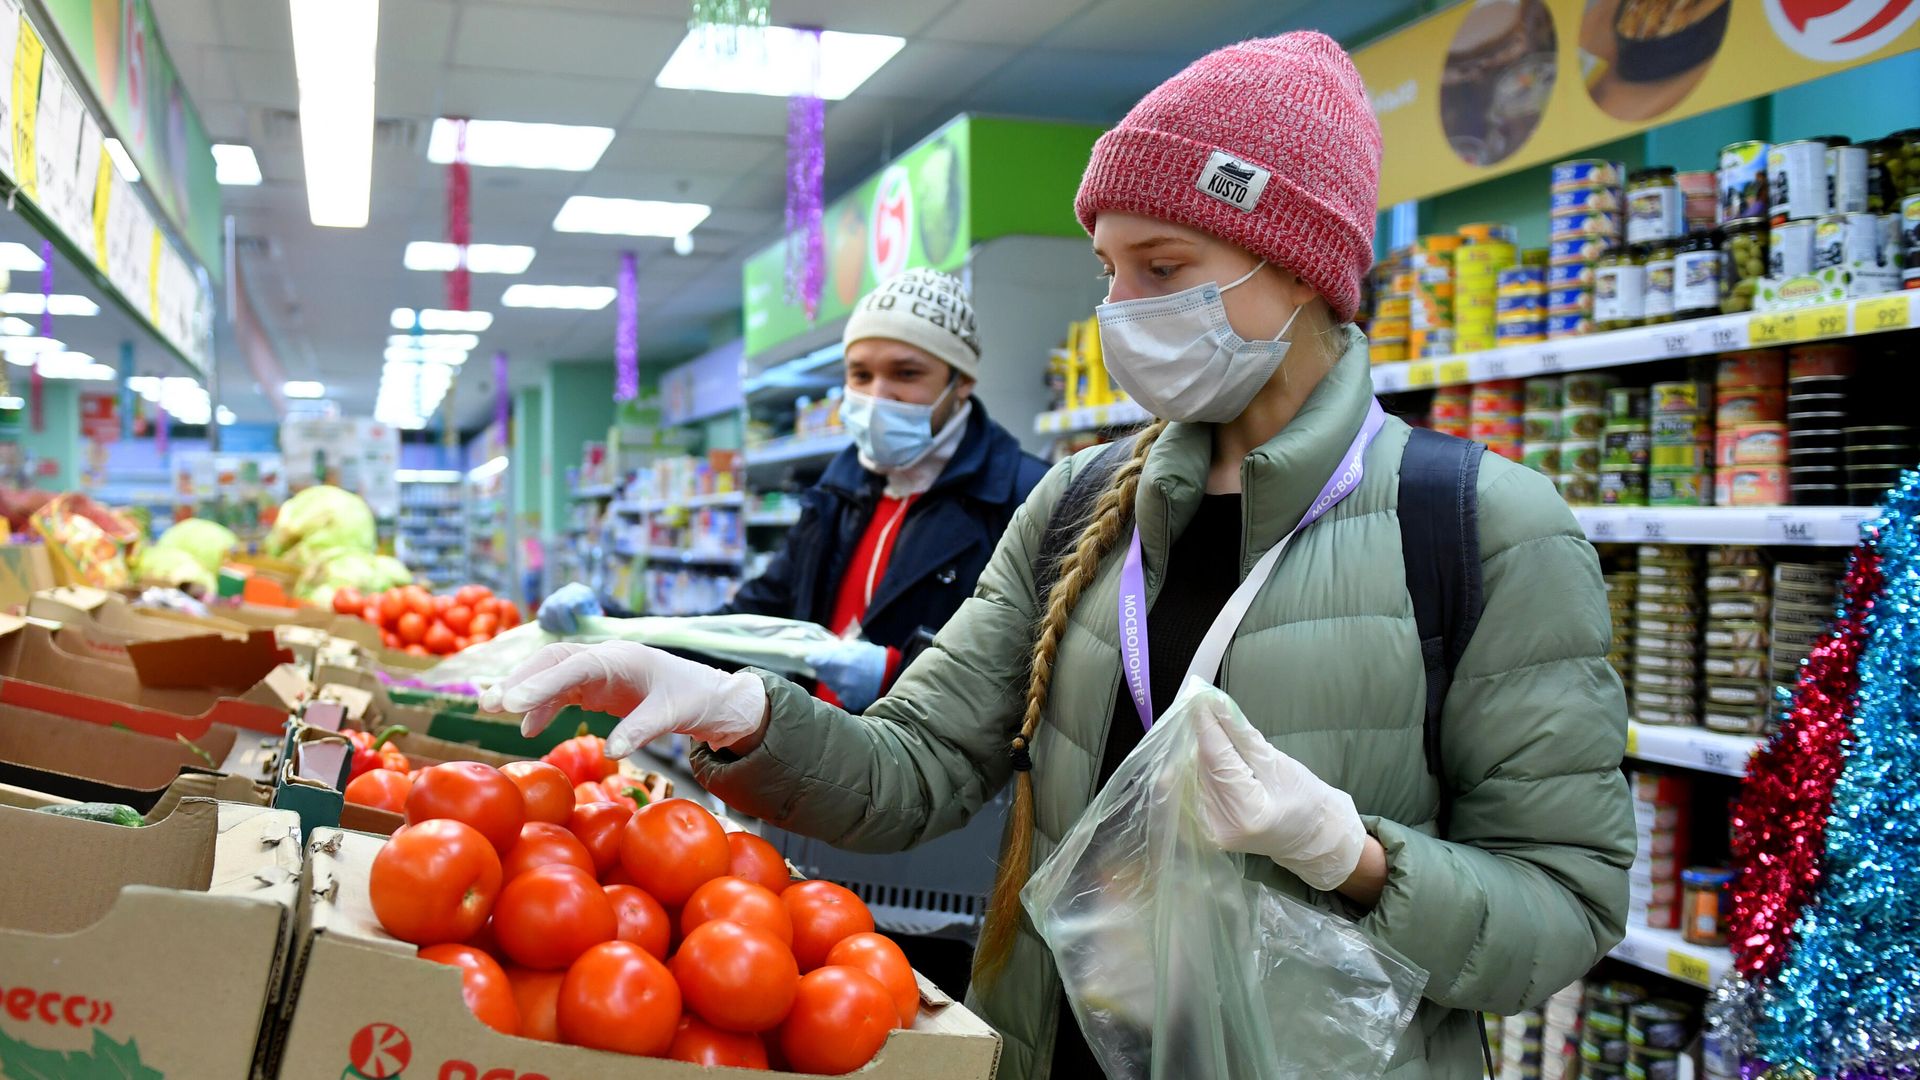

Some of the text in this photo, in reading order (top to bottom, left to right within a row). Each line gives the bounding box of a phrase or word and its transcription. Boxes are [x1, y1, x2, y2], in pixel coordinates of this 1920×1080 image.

[1208, 174, 1248, 204] KUSTO
[1124, 594, 1145, 706] МОСВОЛОНТЁР
[0, 987, 113, 1027] есс»
